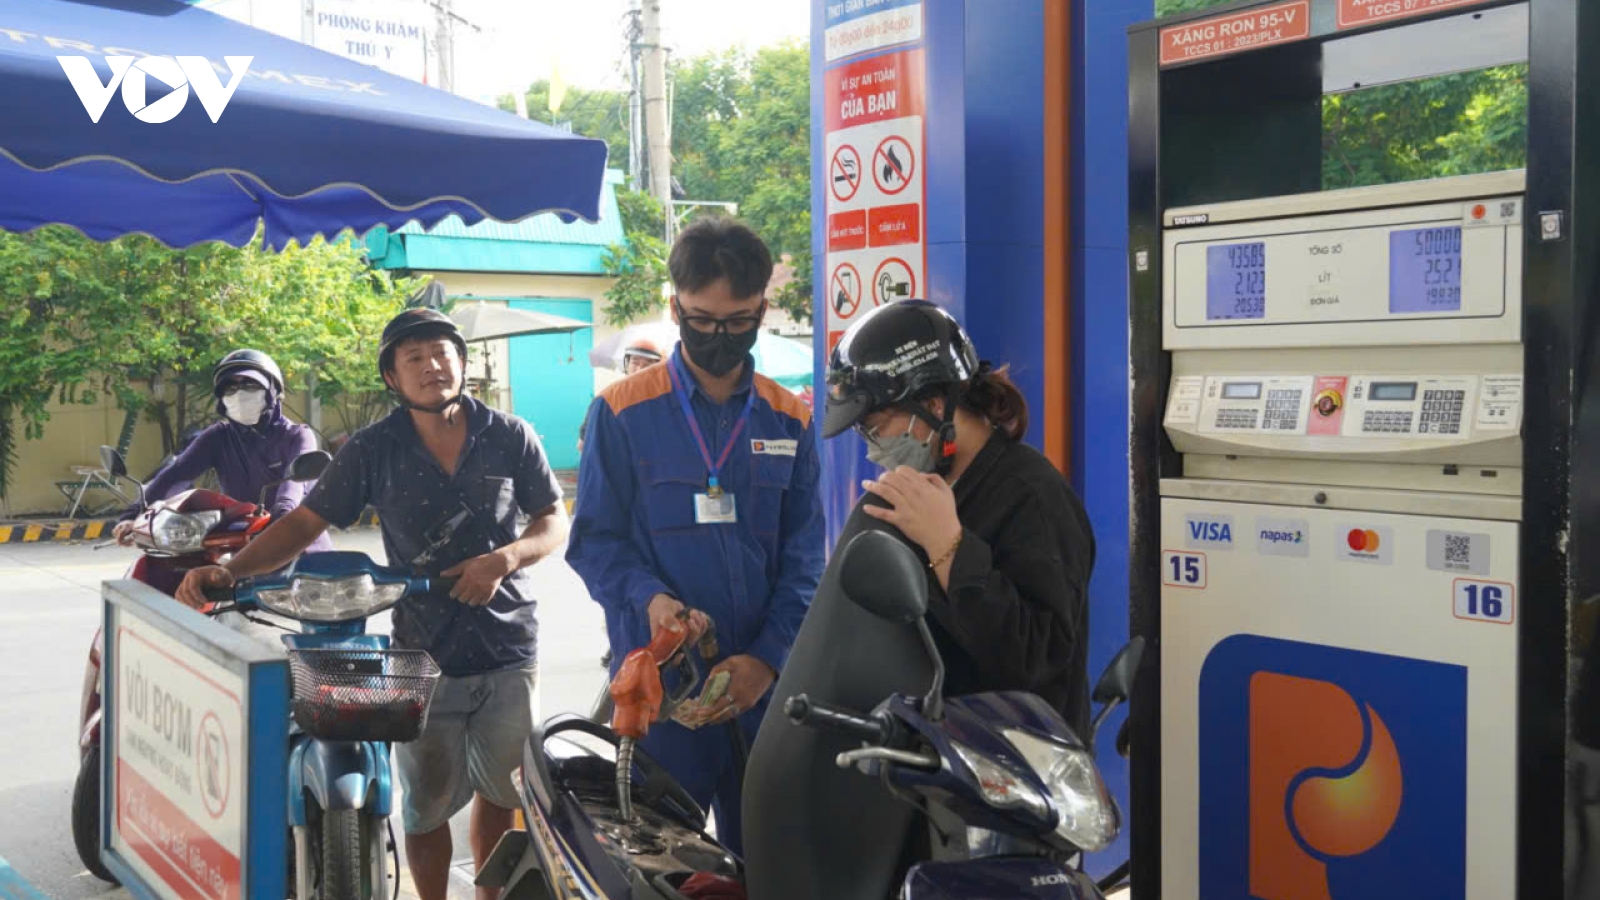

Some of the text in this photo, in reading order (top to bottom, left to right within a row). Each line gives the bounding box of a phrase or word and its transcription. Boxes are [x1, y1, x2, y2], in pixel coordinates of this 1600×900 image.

[1172, 8, 1297, 46] XĂNG RON 95-V
[1184, 43, 1211, 56] TCCS
[841, 89, 896, 120] CỦA BẠN
[1415, 227, 1462, 255] 50000
[1227, 243, 1265, 269] 43585
[1187, 520, 1232, 541] VISA
[1260, 529, 1294, 543] napas
[1169, 555, 1200, 584] 15
[1463, 583, 1503, 618] 16
[153, 687, 192, 757] BƠM
